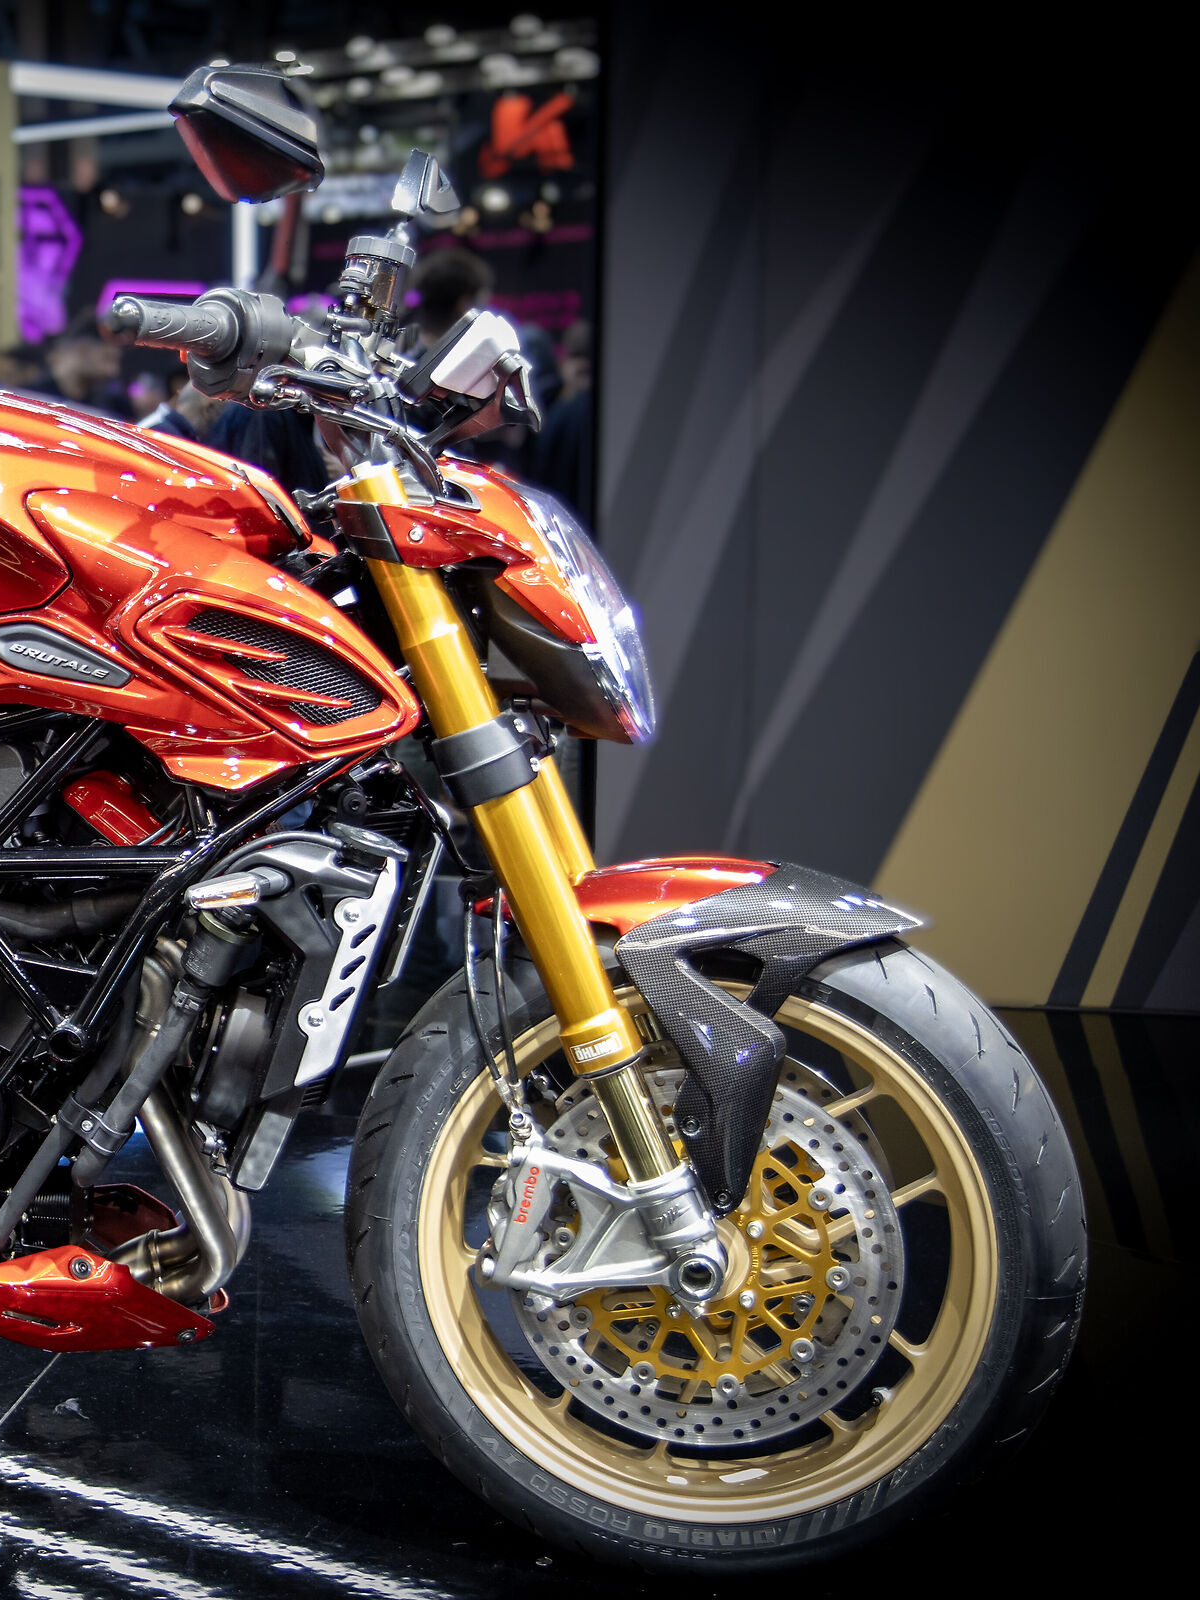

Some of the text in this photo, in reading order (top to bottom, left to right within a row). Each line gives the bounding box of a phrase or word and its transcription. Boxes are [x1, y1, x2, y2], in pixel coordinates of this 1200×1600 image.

[8, 642, 110, 679] BRUTALE
[512, 1166, 540, 1224] brembo
[528, 1471, 632, 1532] ROSSO
[642, 1520, 778, 1547] DIABLO
